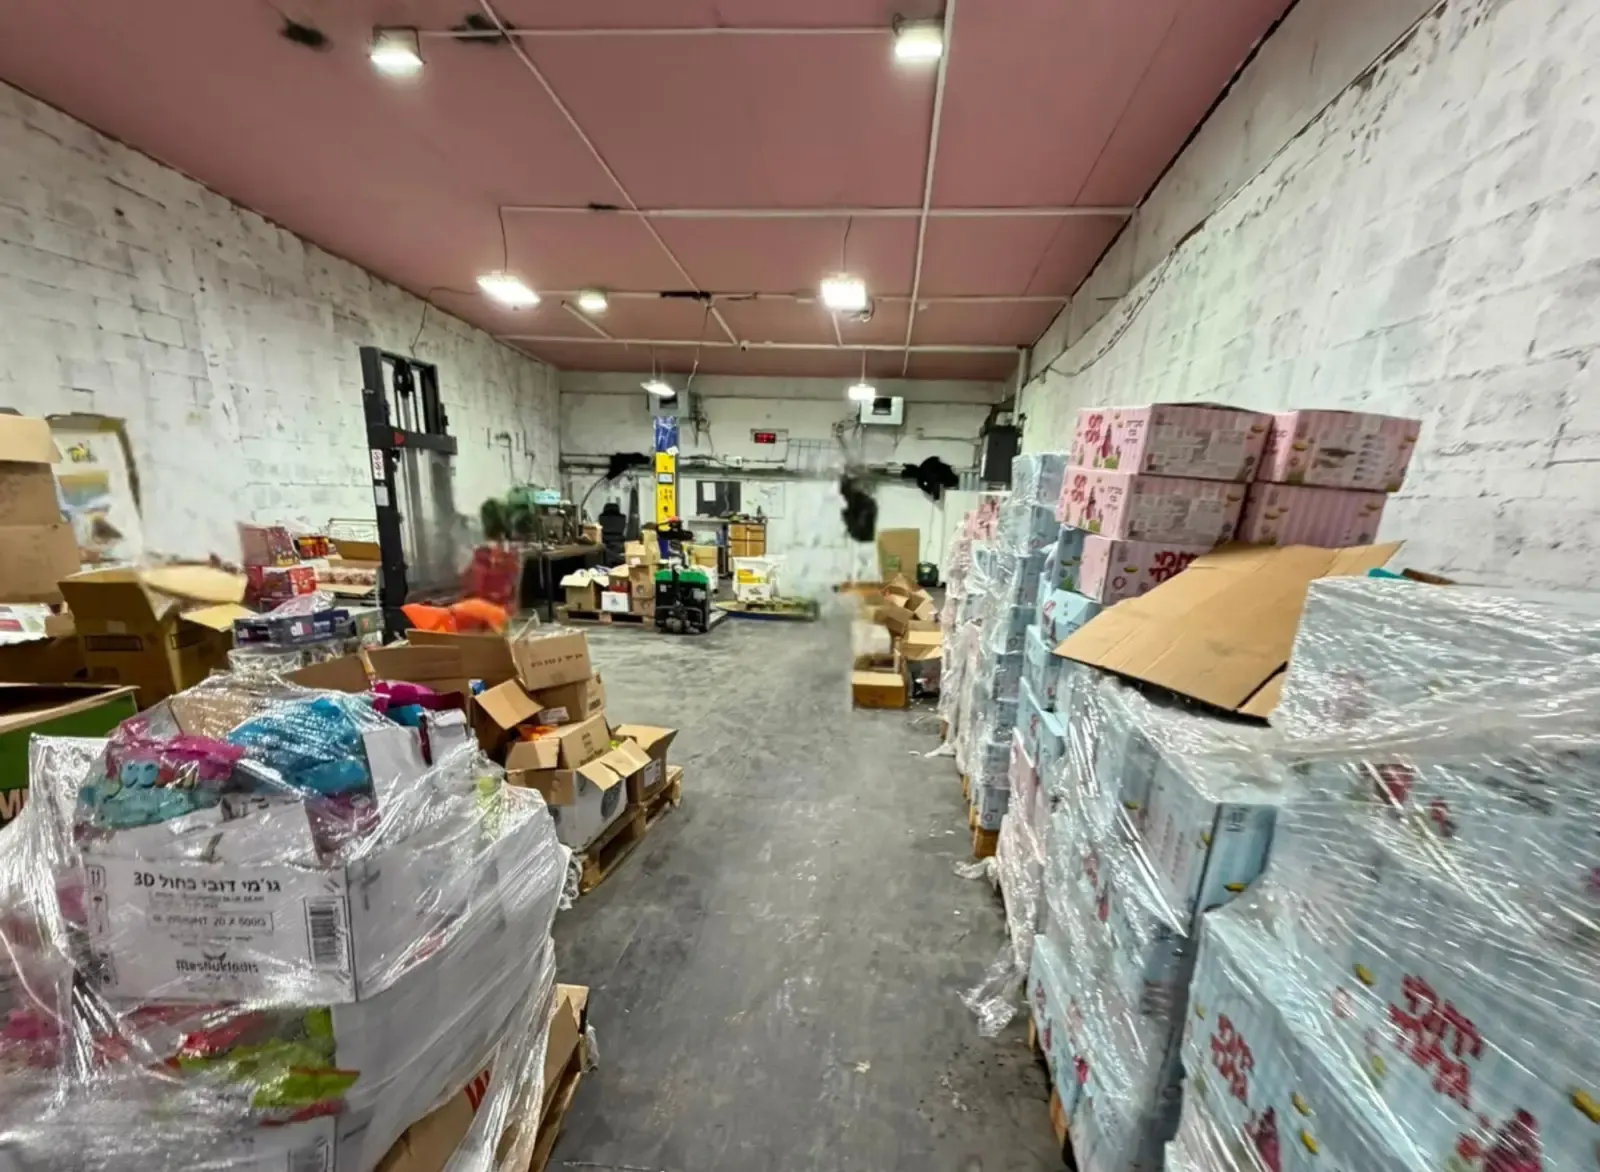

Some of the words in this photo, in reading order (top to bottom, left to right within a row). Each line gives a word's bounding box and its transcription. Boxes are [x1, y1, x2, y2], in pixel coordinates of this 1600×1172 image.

[133, 871, 155, 887] 3D
[159, 874, 197, 890] כחול
[202, 879, 236, 892] דובי
